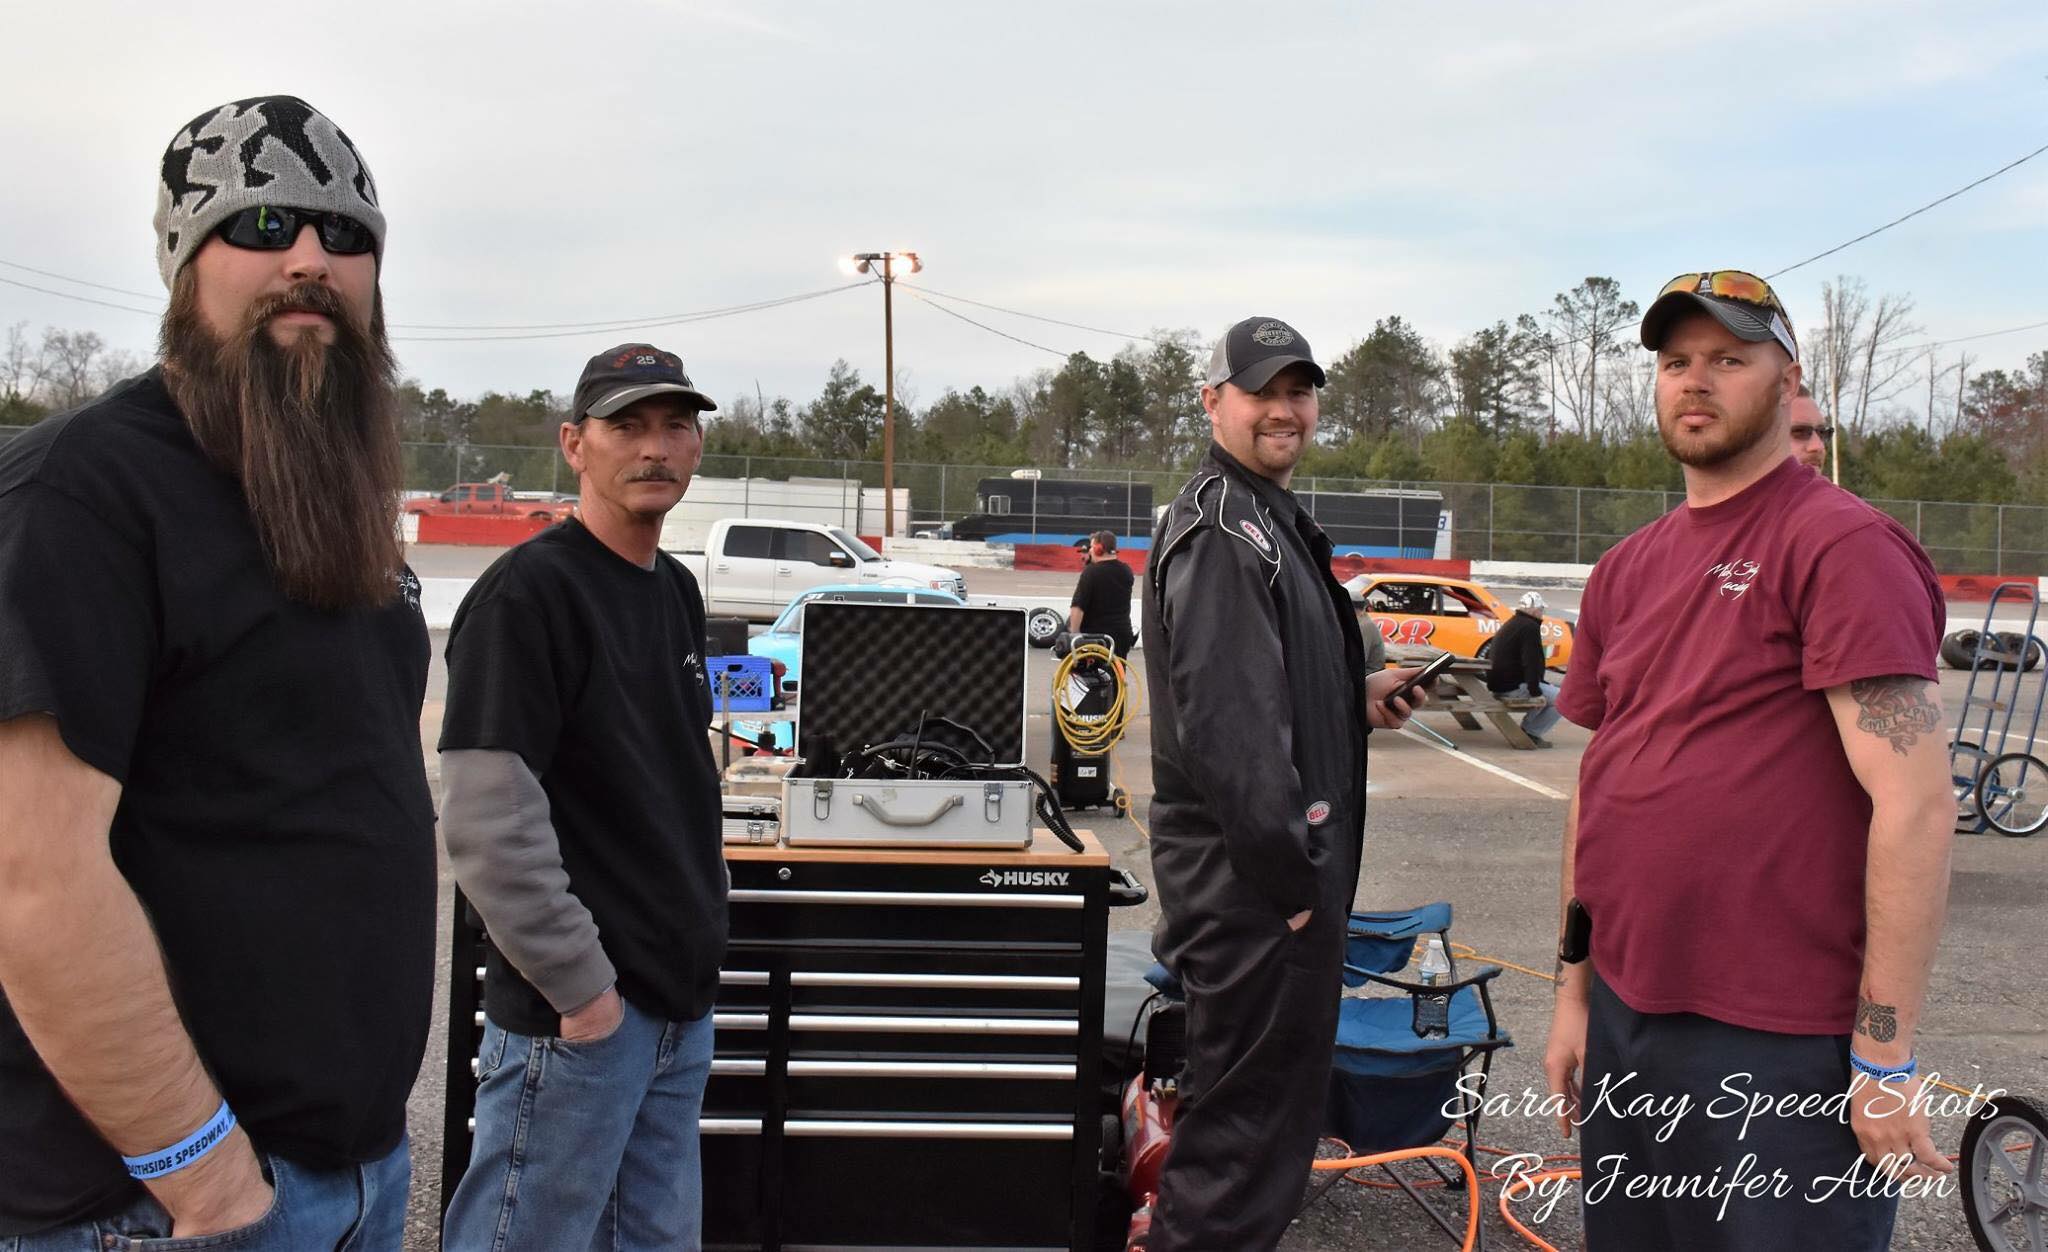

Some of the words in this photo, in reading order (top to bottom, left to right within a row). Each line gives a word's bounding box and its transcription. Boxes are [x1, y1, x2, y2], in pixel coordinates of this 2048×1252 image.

[636, 355, 656, 365] 25
[1003, 871, 1070, 886] HUSKY
[1855, 996, 1897, 1043] 25
